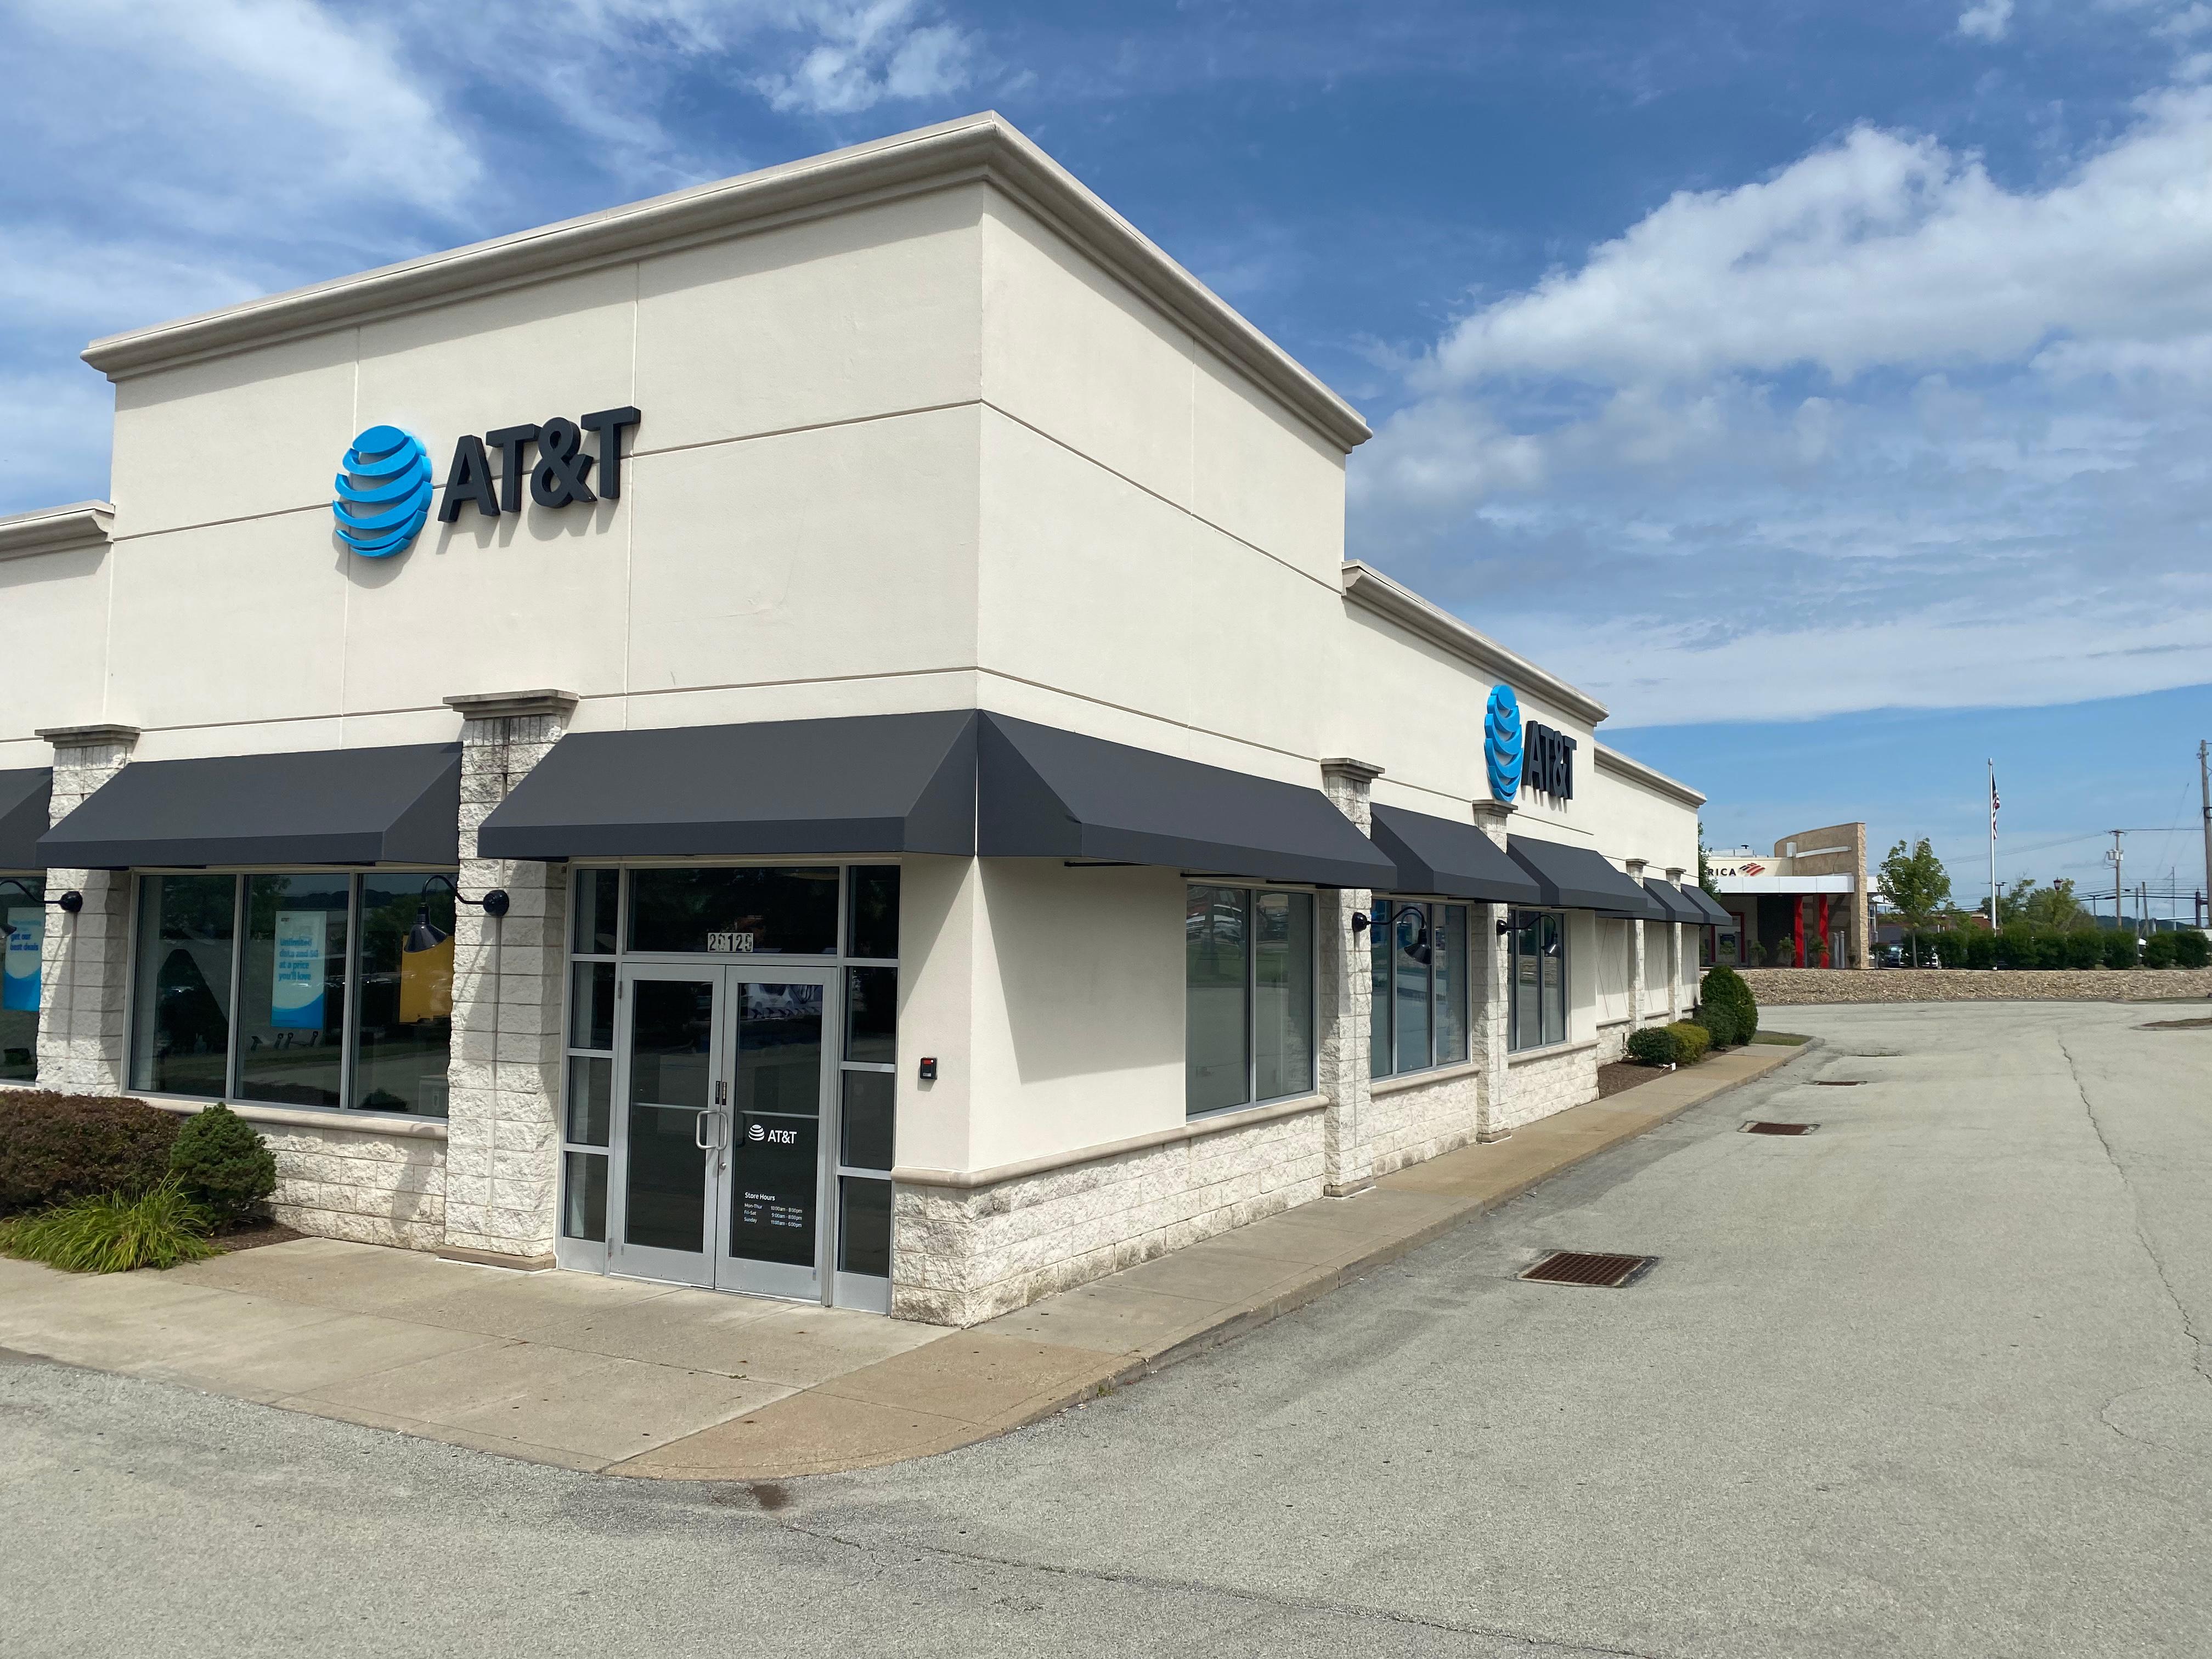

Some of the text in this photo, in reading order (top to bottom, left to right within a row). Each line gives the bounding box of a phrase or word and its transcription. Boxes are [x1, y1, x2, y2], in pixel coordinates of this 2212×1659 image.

[438, 406, 641, 522] AT&T
[1521, 720, 1577, 800] AT&T
[292, 961, 309, 971] price
[297, 972, 311, 980] love
[768, 1130, 797, 1144] AT&T
